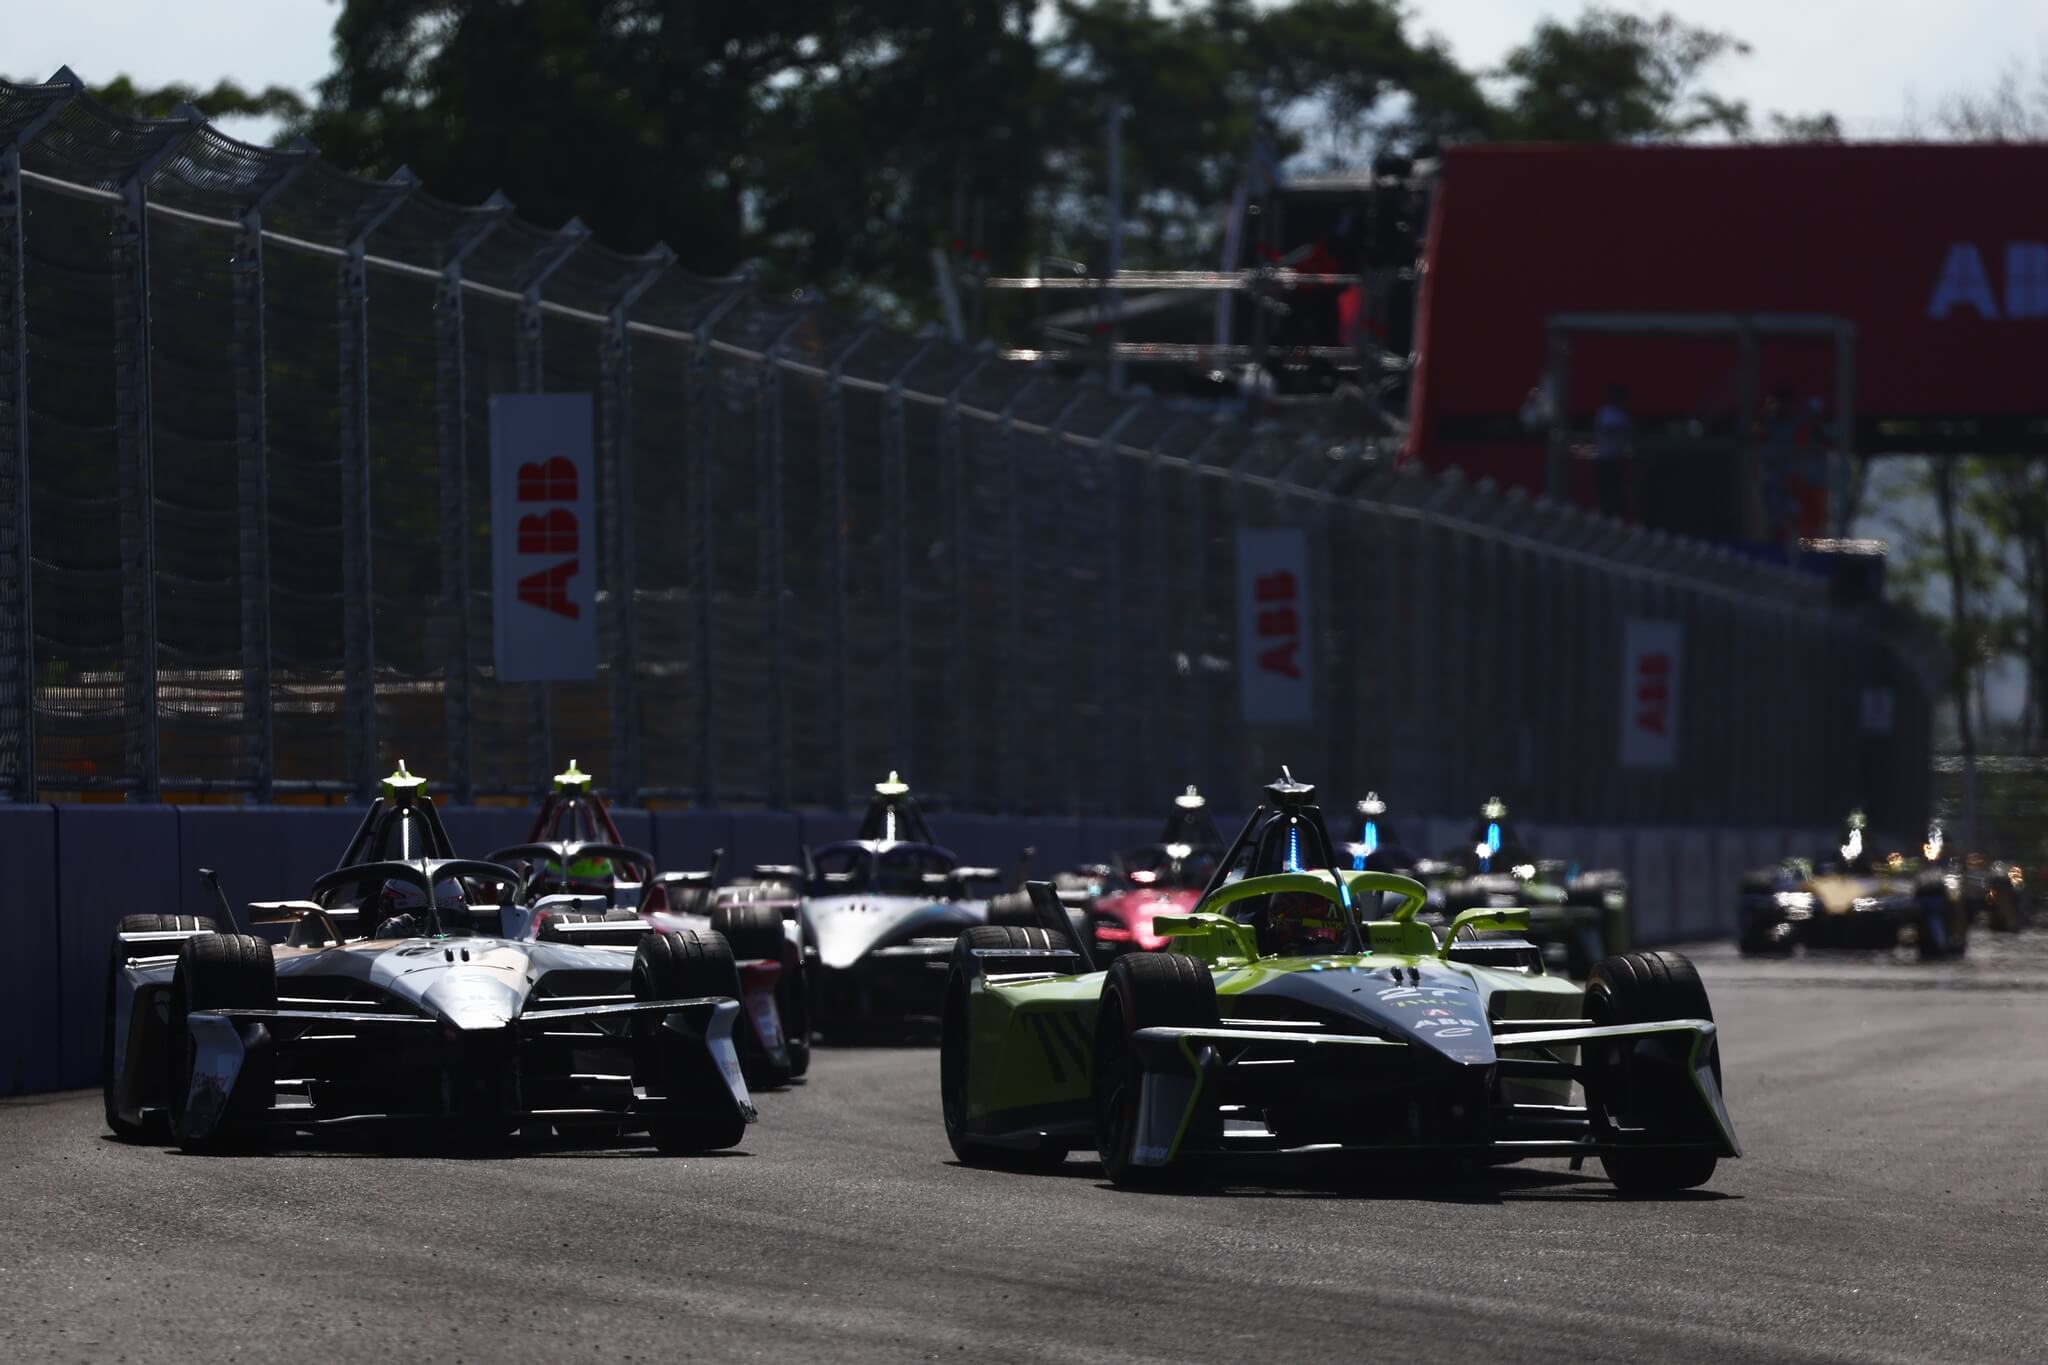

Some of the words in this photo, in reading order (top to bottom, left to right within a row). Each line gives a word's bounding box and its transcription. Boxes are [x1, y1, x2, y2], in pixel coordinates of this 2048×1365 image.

[517, 456, 580, 620] ABB
[1256, 571, 1301, 679] ABB
[1637, 653, 1670, 736] ABB
[1414, 1018, 1480, 1029] ABB
